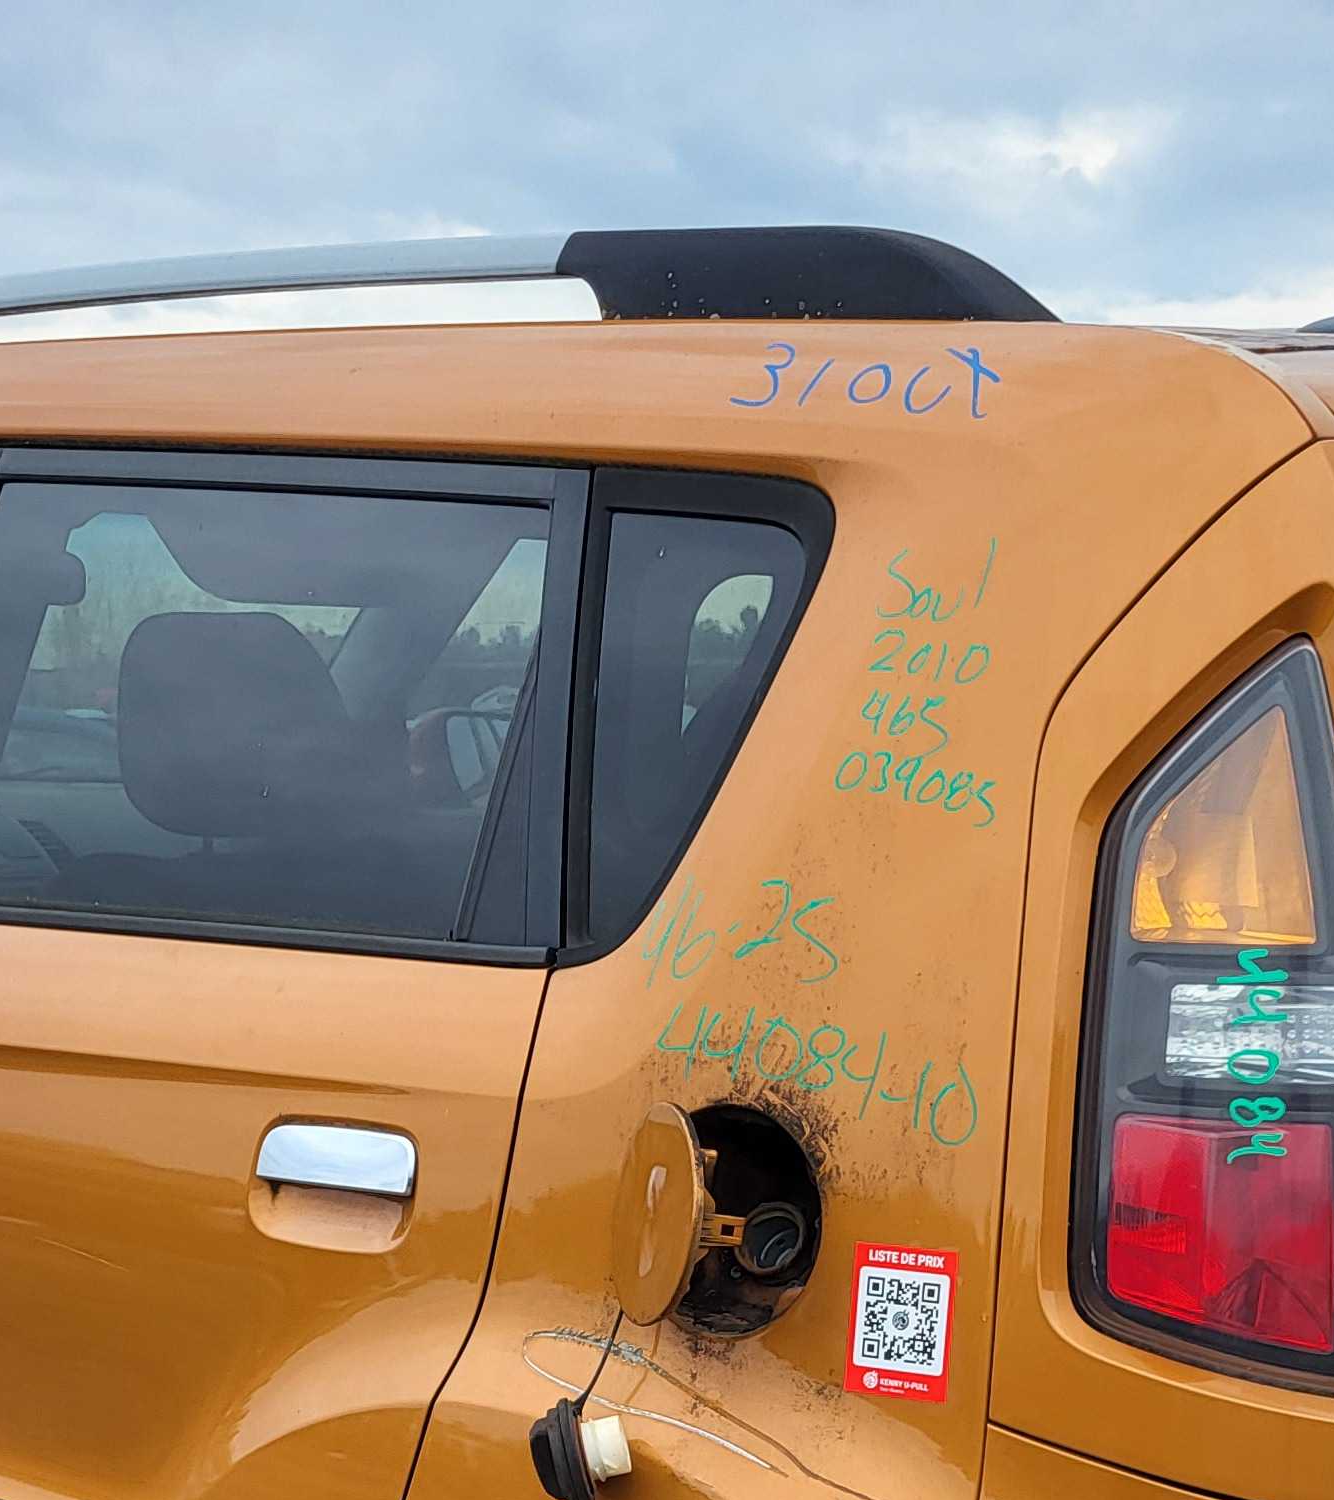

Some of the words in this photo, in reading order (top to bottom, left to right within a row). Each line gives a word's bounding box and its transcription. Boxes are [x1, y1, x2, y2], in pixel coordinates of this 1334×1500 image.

[876, 537, 997, 623] Soul
[868, 628, 991, 684] 2010
[868, 1248, 900, 1265] LISTE
[900, 1252, 917, 1267] DE
[917, 1254, 945, 1269] PRIX
